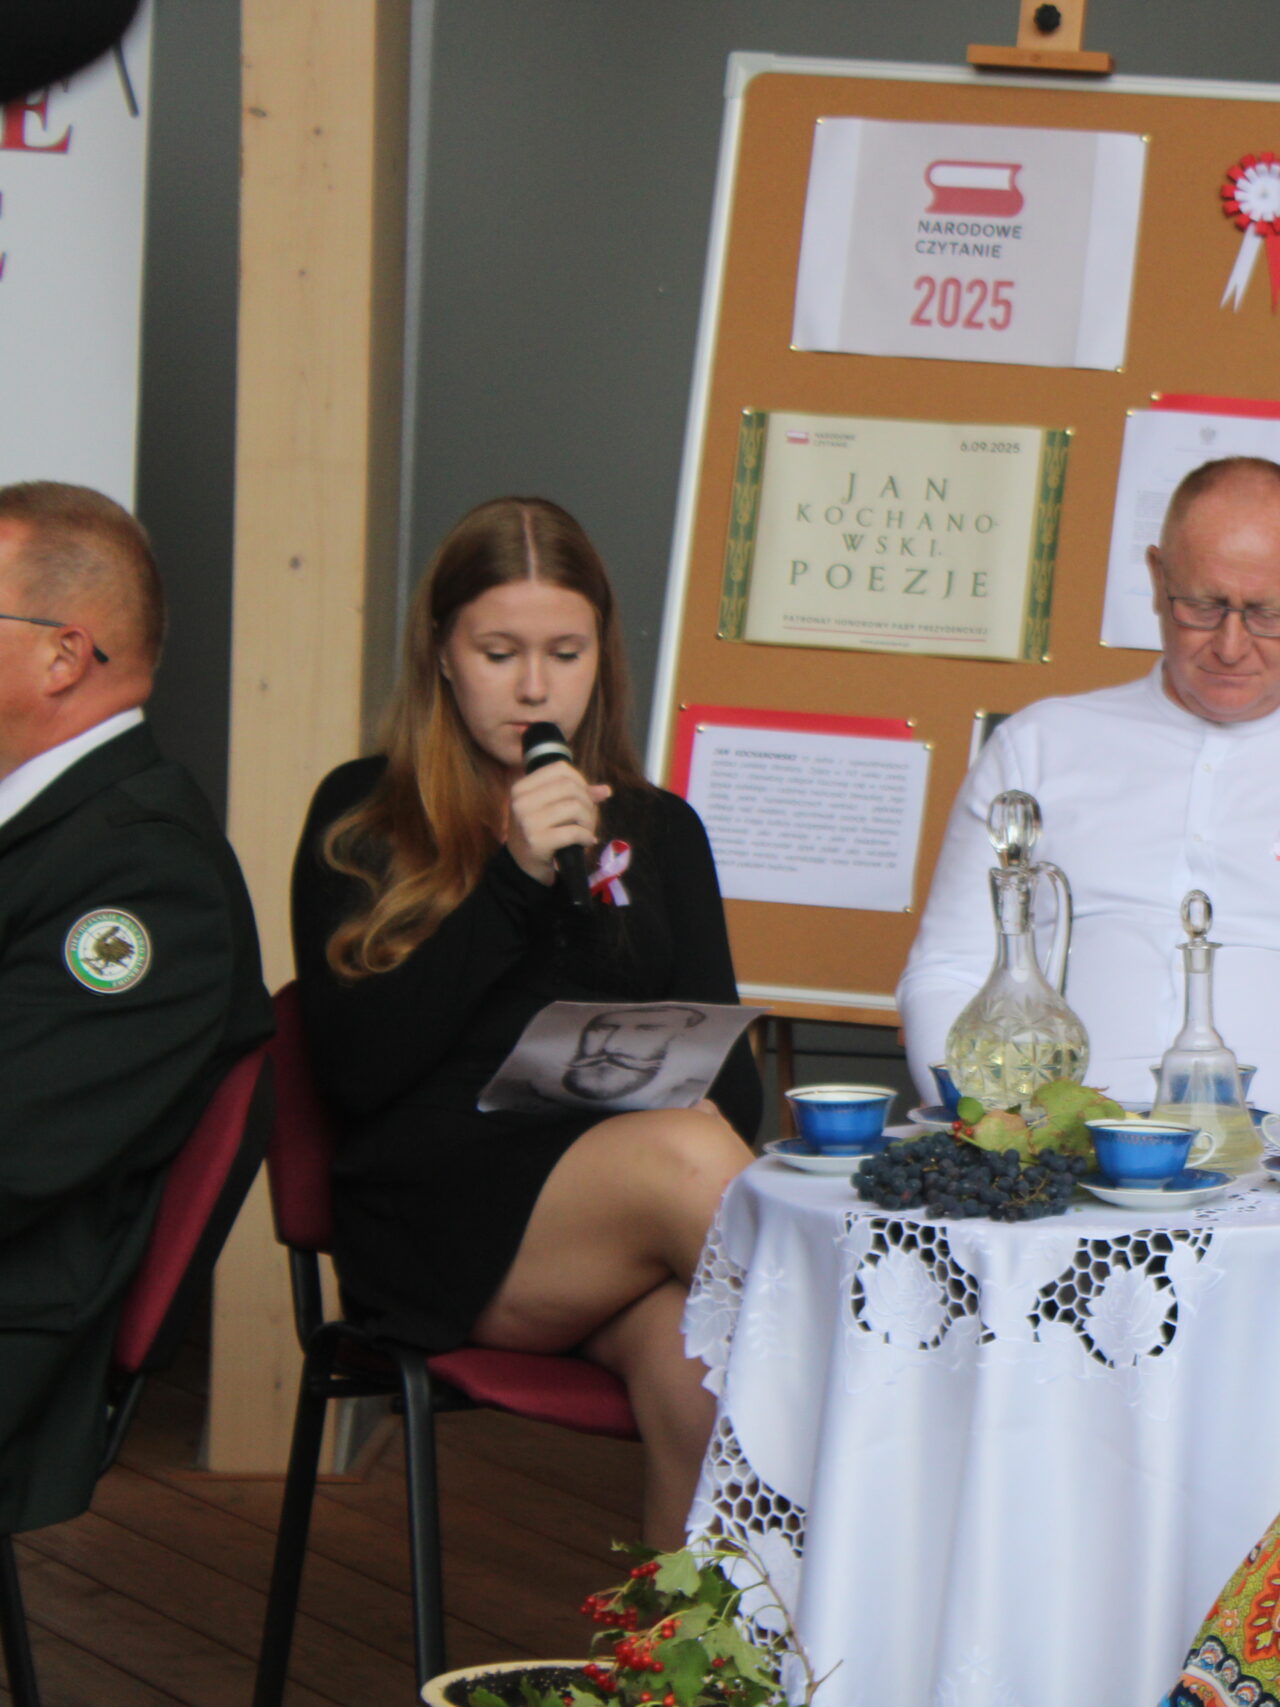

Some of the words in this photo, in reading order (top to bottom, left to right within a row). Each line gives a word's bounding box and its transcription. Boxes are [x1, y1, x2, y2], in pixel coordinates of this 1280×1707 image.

[918, 220, 1022, 239] NARODOWE
[915, 240, 1002, 258] CZYTANIE
[910, 275, 1015, 331] 2025
[960, 440, 1020, 453] 6.09.2025
[841, 472, 948, 504] JAN
[788, 560, 988, 599] POEZJE
